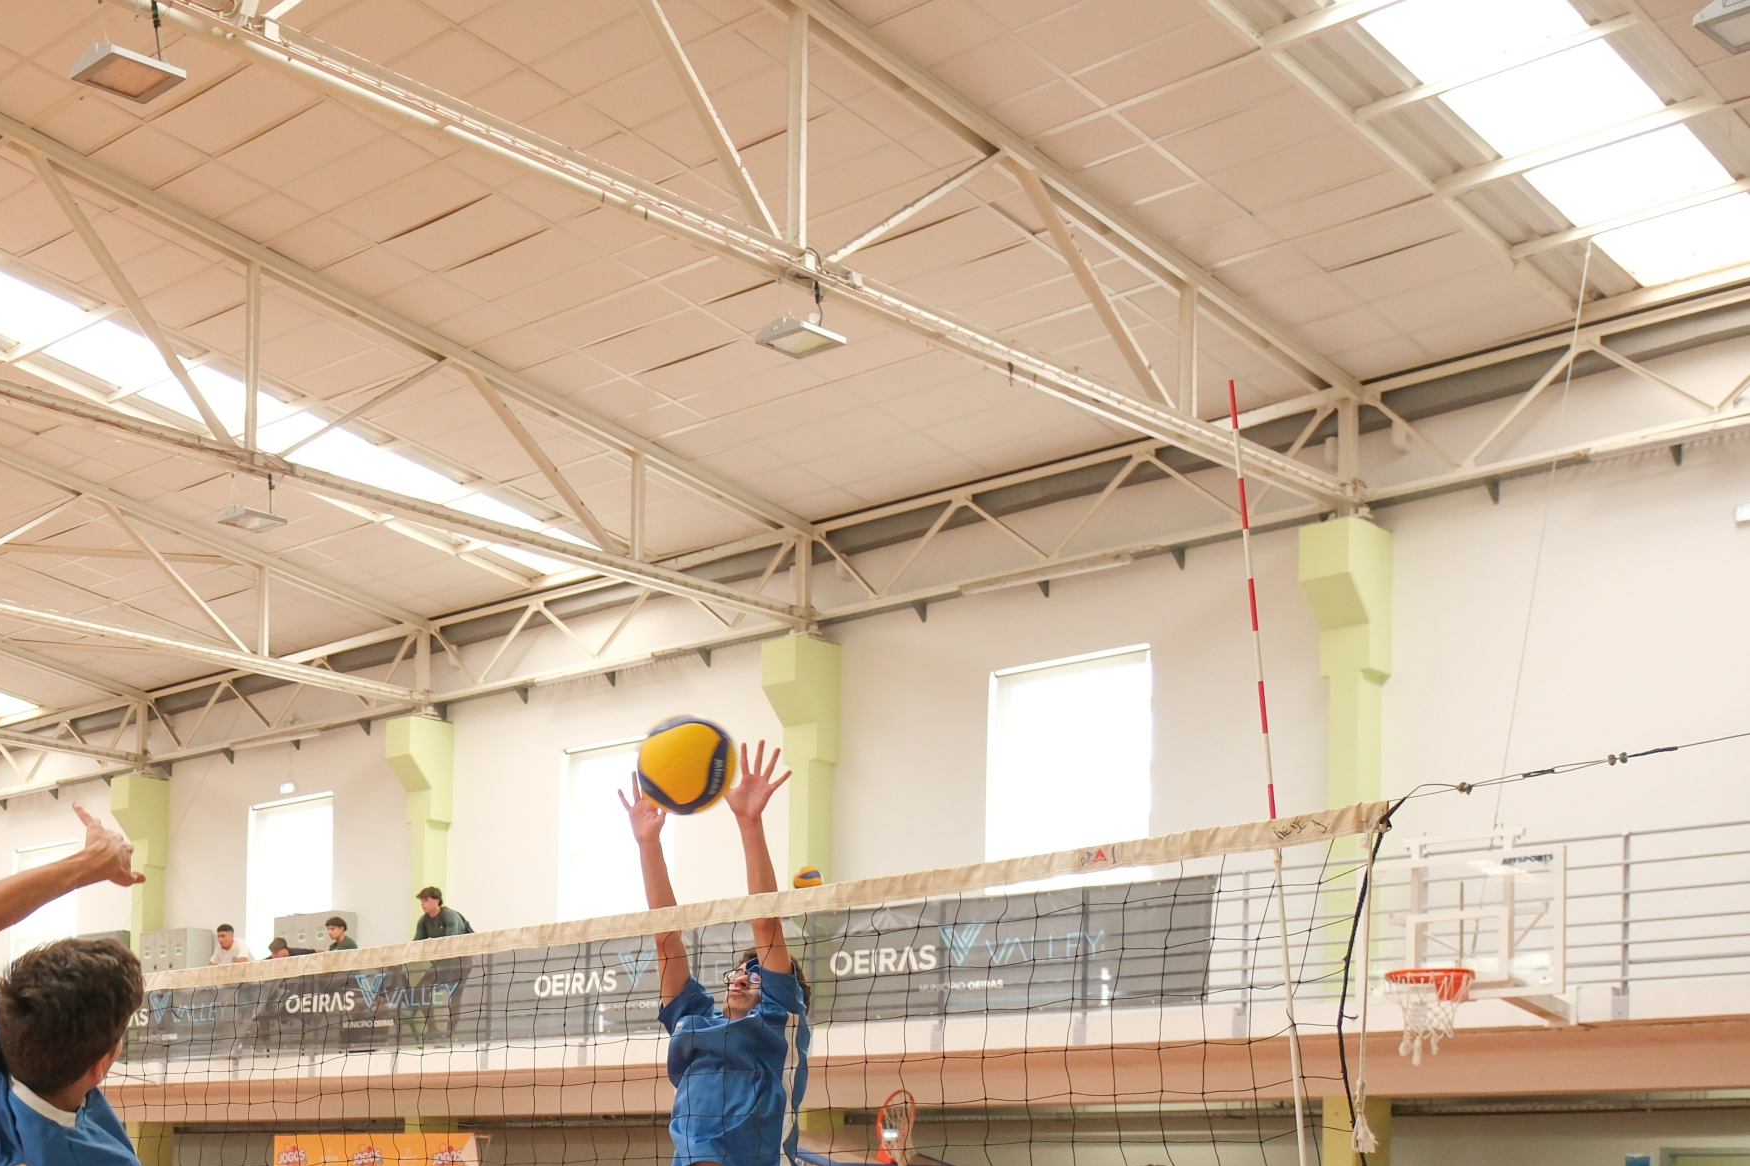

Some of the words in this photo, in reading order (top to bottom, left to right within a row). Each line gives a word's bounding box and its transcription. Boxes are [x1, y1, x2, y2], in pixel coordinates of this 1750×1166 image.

[829, 944, 937, 976] OEIRAS
[985, 929, 1105, 965] VALLEY
[285, 991, 355, 1014] OEIRAS
[383, 981, 459, 1008] VALLEY
[533, 969, 618, 998] OEIRAS
